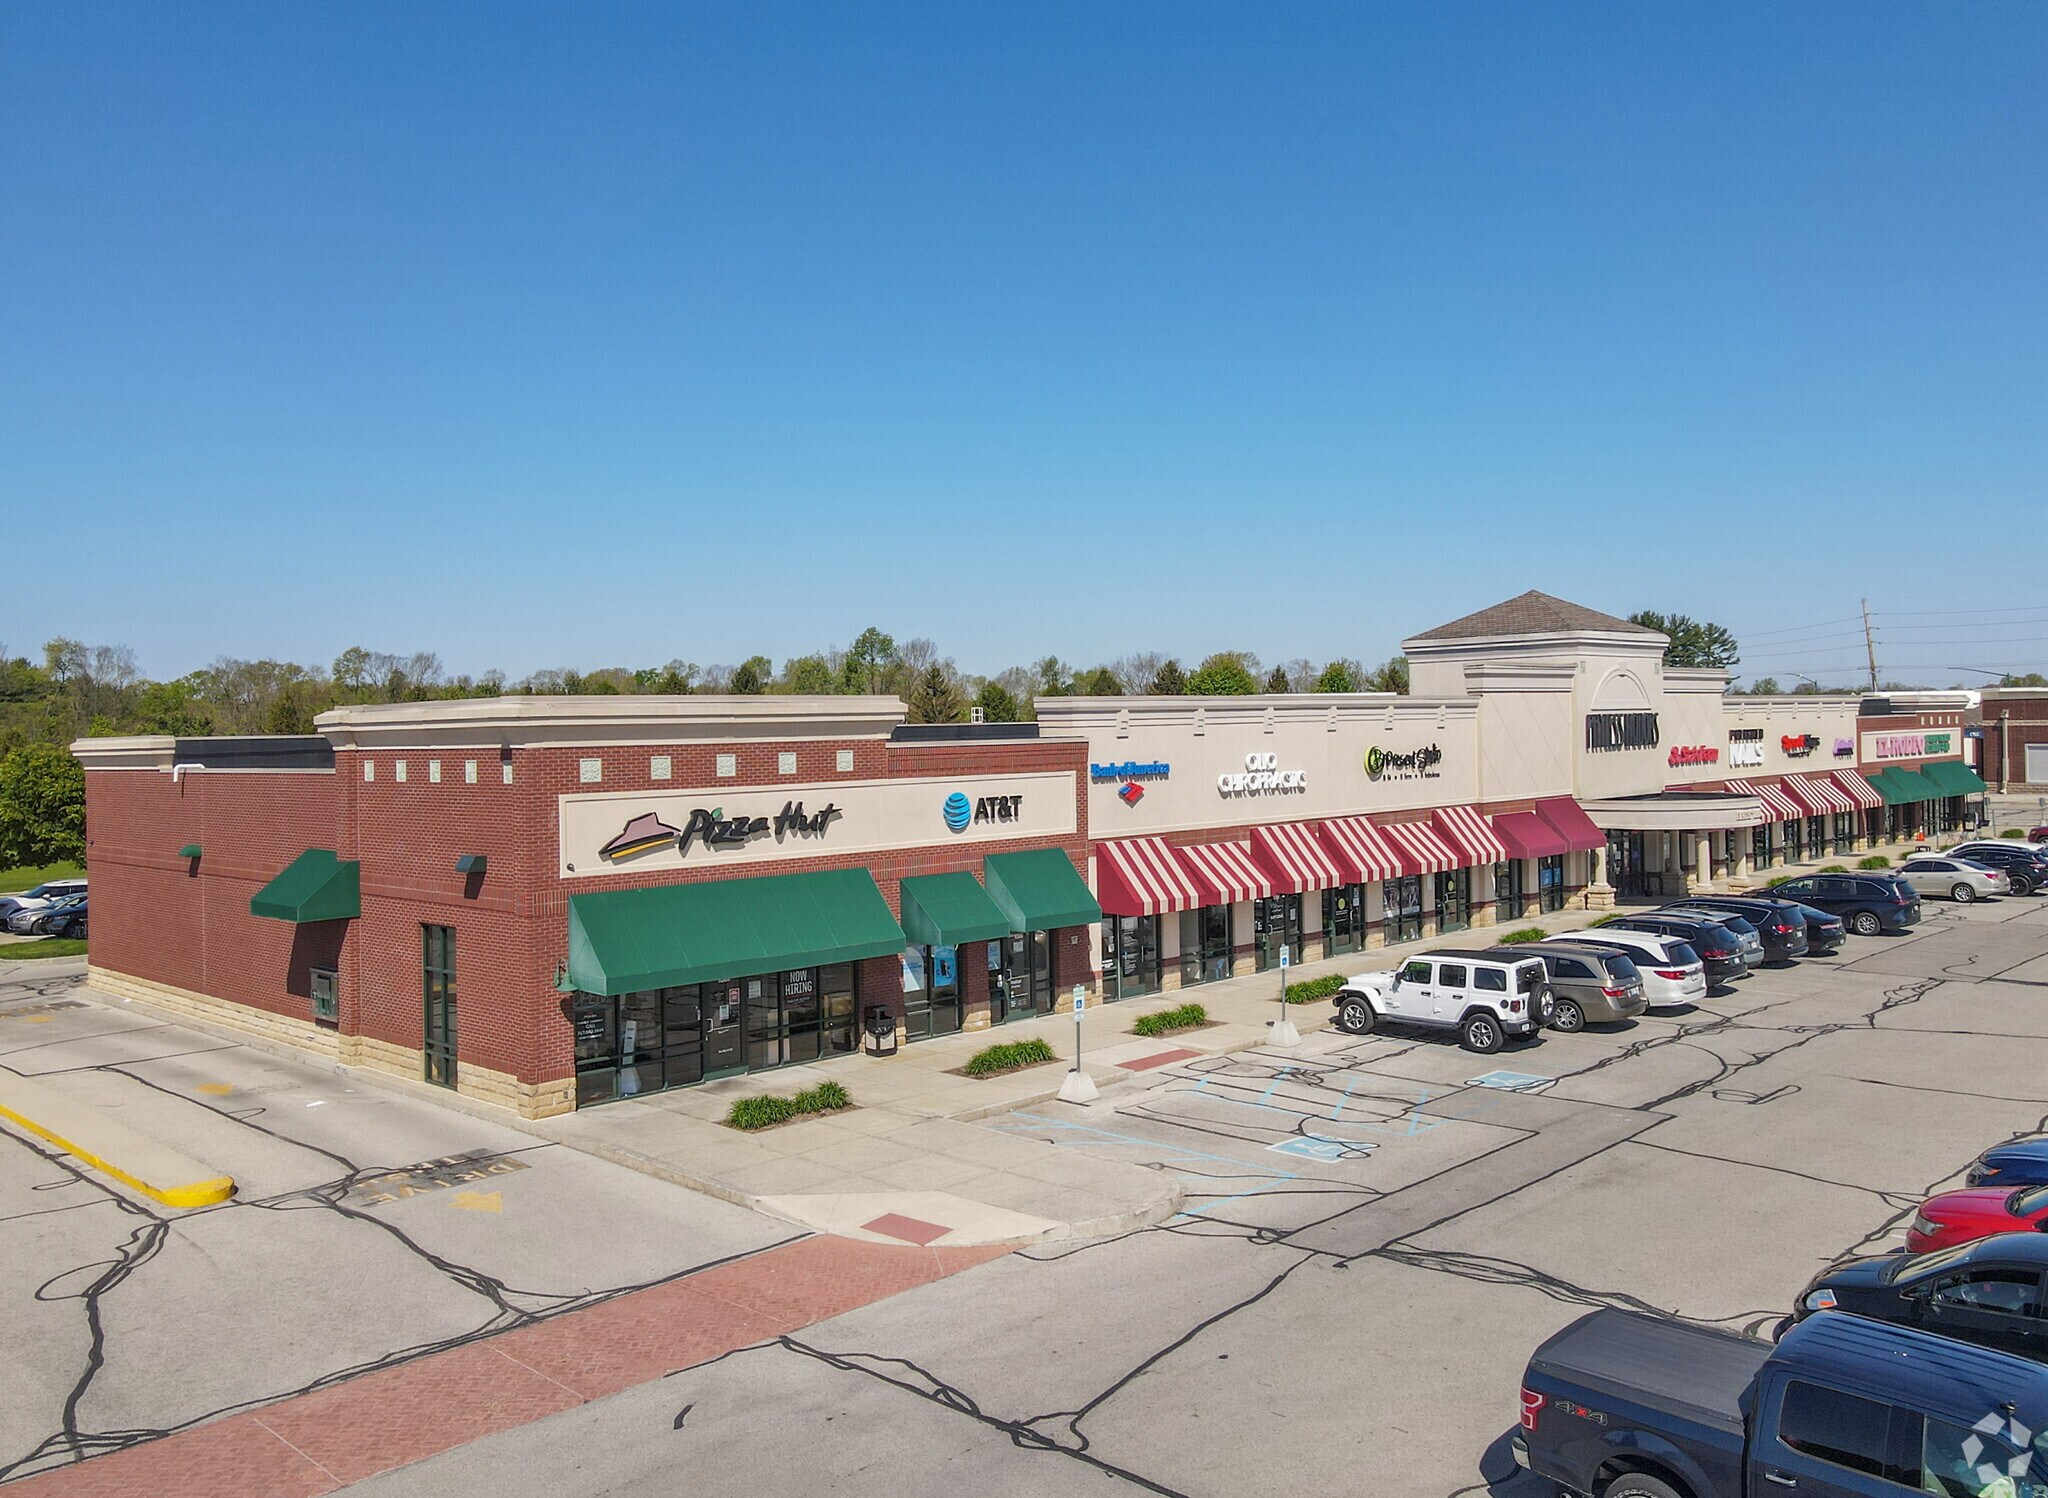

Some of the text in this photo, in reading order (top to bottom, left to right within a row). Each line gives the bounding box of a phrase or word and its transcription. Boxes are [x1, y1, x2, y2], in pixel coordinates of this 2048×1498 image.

[974, 795, 1023, 821] AT&T
[678, 800, 842, 852] Pizza Hut
[790, 970, 807, 983] NOW
[785, 981, 812, 996] HIRING
